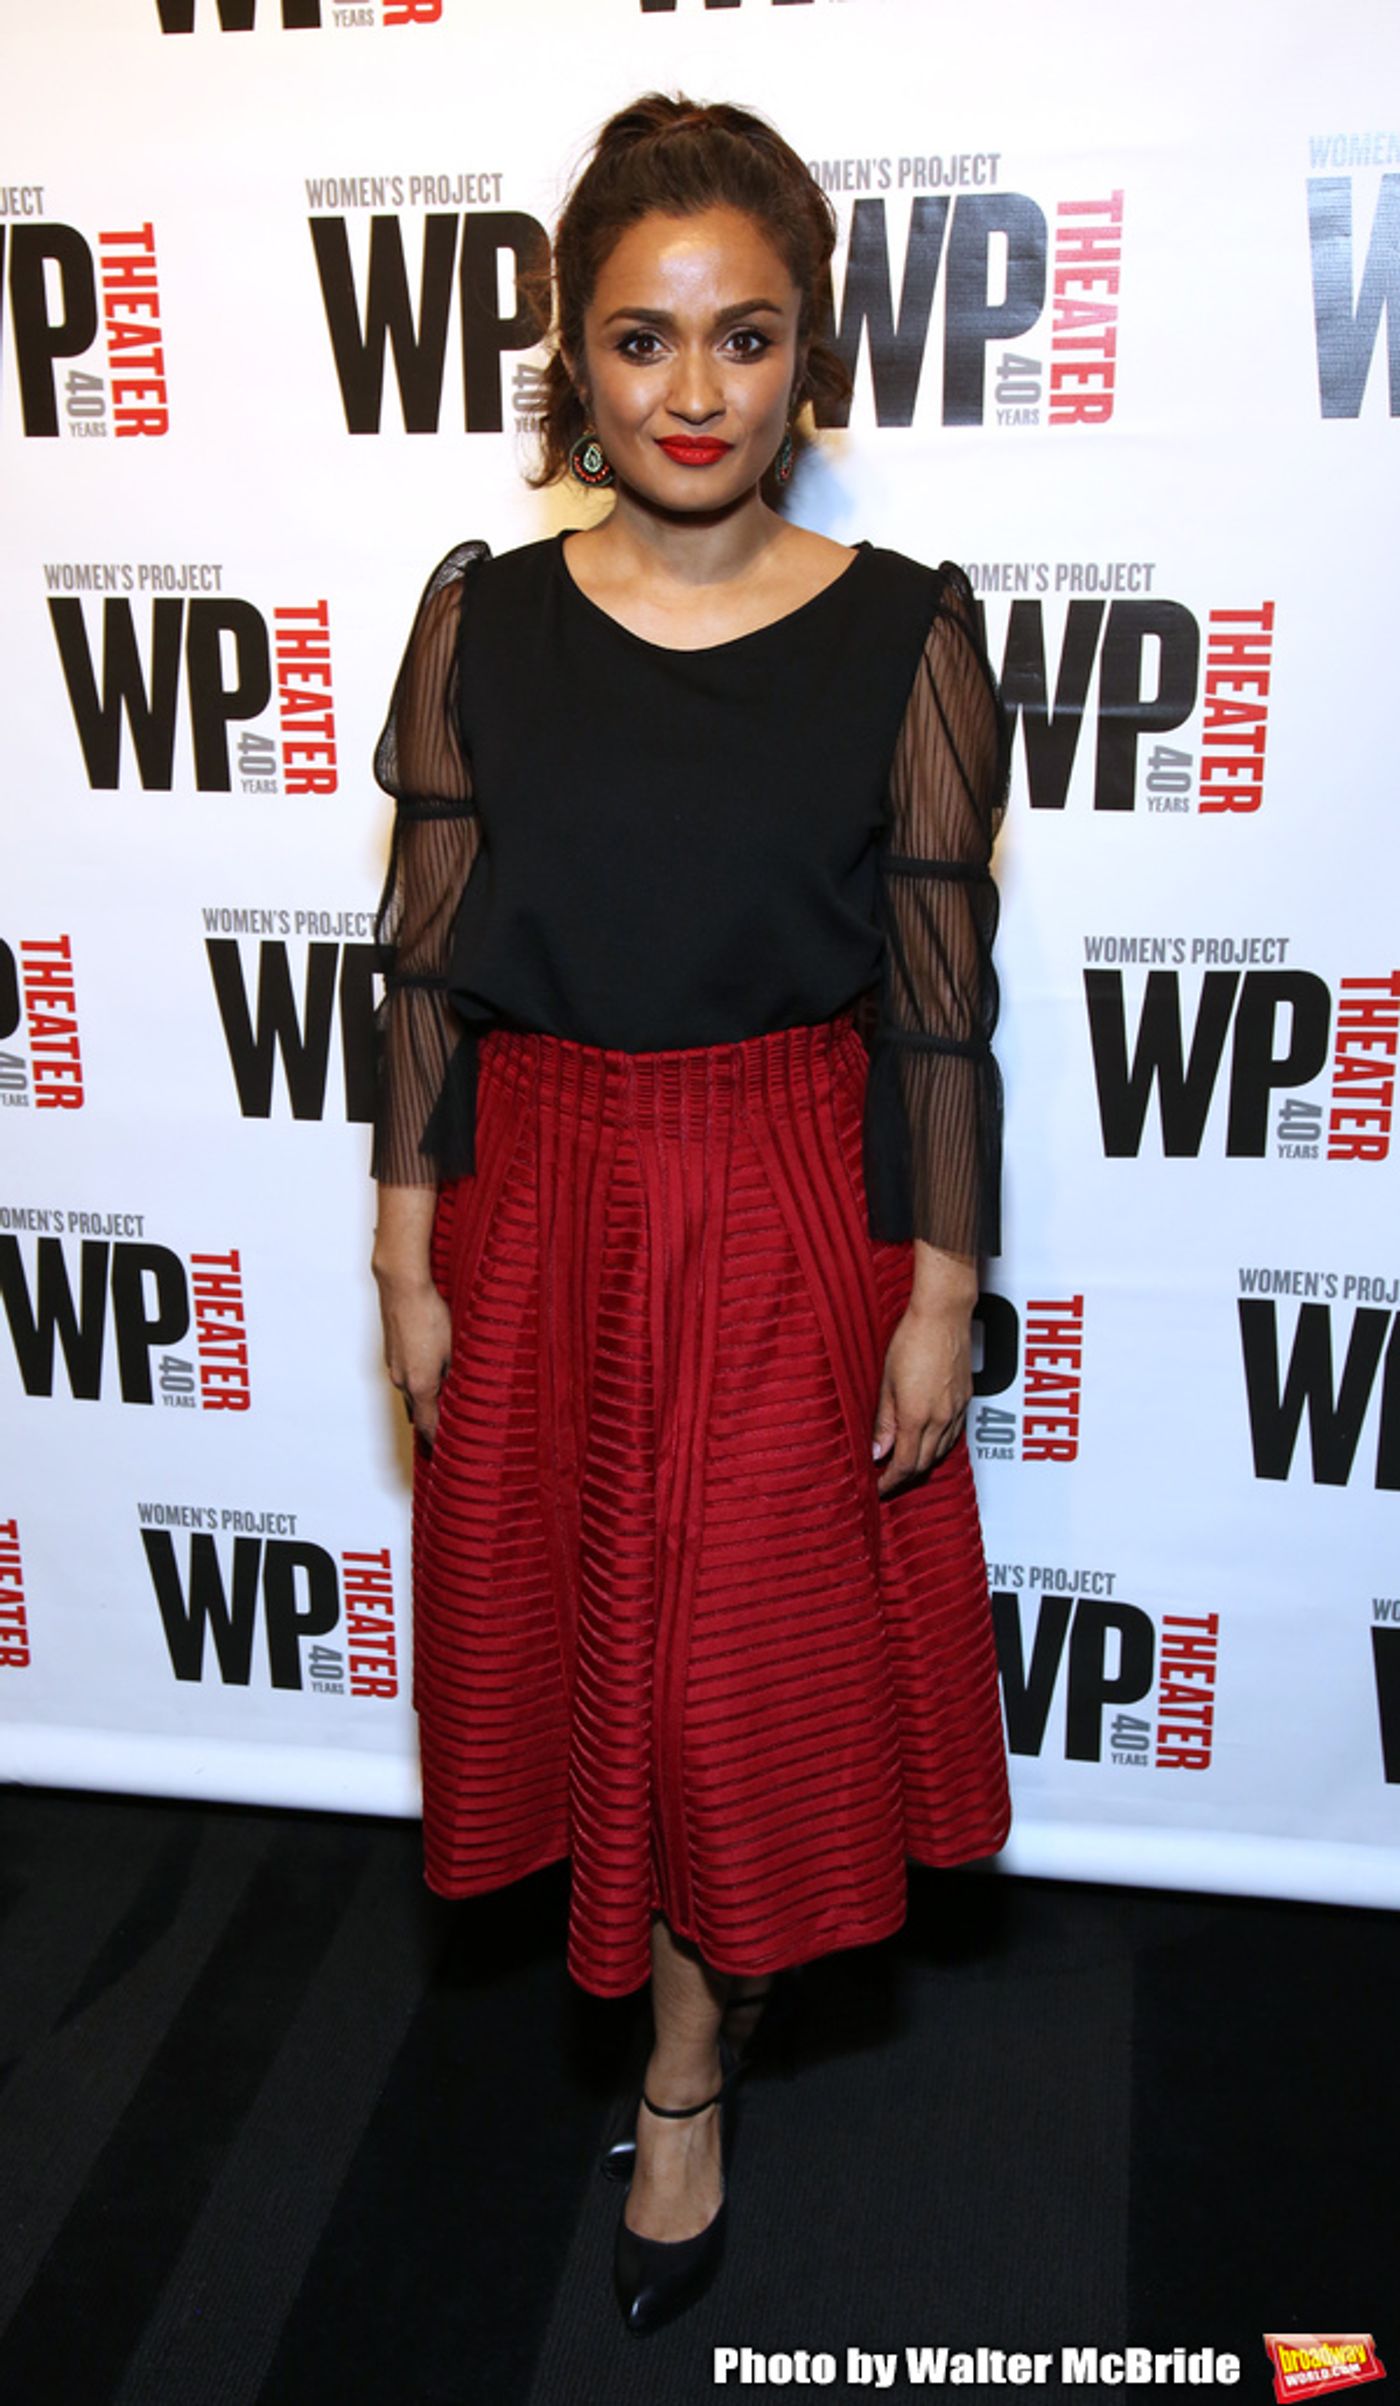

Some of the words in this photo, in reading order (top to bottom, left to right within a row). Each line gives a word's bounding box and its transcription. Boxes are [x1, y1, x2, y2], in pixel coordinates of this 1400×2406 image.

[332, 8, 375, 27] YEARS
[1308, 131, 1400, 169] WOMEN
[305, 177, 405, 208] WOMEN'S
[410, 173, 503, 205] PROJECT
[806, 158, 891, 192] OMEN'S
[897, 153, 1001, 188] PROJECT
[0, 186, 44, 216] JECT
[1048, 189, 1124, 425] THEATER
[1305, 172, 1400, 419] W
[0, 222, 98, 438] P
[98, 222, 169, 438] THEATER
[308, 211, 552, 435] WP
[65, 369, 106, 417] 40
[995, 352, 1042, 405] 40
[69, 421, 107, 437] YEARS
[996, 407, 1040, 426] YEARS
[44, 564, 134, 591] WOMEN'S
[138, 565, 223, 592] PROJECT
[961, 562, 1049, 592] OMEN'S
[1055, 562, 1156, 592] PROJECT
[47, 597, 272, 792] WP
[274, 599, 339, 796] THEATER
[974, 599, 1200, 811] WP
[1198, 601, 1275, 814] THEATER
[236, 731, 277, 776] 40
[1146, 745, 1193, 793] 40
[240, 779, 278, 795] YEARS
[1147, 796, 1190, 814] YEARS
[202, 907, 291, 935] WOMEN'S
[294, 910, 379, 937] PROJECT
[1083, 936, 1185, 965] WOMEN'S
[1192, 937, 1290, 965] PROJECT
[20, 934, 84, 1109] THEATER
[1083, 968, 1332, 1158] WP
[1327, 970, 1400, 1161] THEATER
[0, 1093, 29, 1107] EARS
[1276, 1098, 1323, 1142] 40
[1277, 1143, 1319, 1159] YEARS
[0, 1207, 64, 1233] OMEN'S
[68, 1211, 144, 1237] PROJECT
[1239, 1268, 1338, 1298] WOMEN'S
[1344, 1274, 1400, 1303] PROJ
[0, 1234, 190, 1406] WP
[190, 1249, 251, 1412] THEATER
[159, 1355, 196, 1393] 40
[1022, 1295, 1084, 1463] THEATER
[162, 1394, 197, 1409] YEARS
[1238, 1298, 1400, 1491] W
[974, 1405, 1016, 1445] 40
[975, 1446, 1014, 1461] YEARS
[138, 1503, 218, 1531] WOMEN'S
[222, 1510, 297, 1535] PROJECT
[986, 1563, 1025, 1588] EN'S
[1029, 1566, 1116, 1596] PROJECT
[140, 1528, 340, 1691] WP
[342, 1548, 399, 1699] THEATER
[309, 1645, 345, 1681] 40
[310, 1681, 345, 1695] YEARS
[1155, 1612, 1219, 1771] THEATER
[1110, 1712, 1151, 1751] 40
[1111, 1751, 1148, 1767] YEARS
